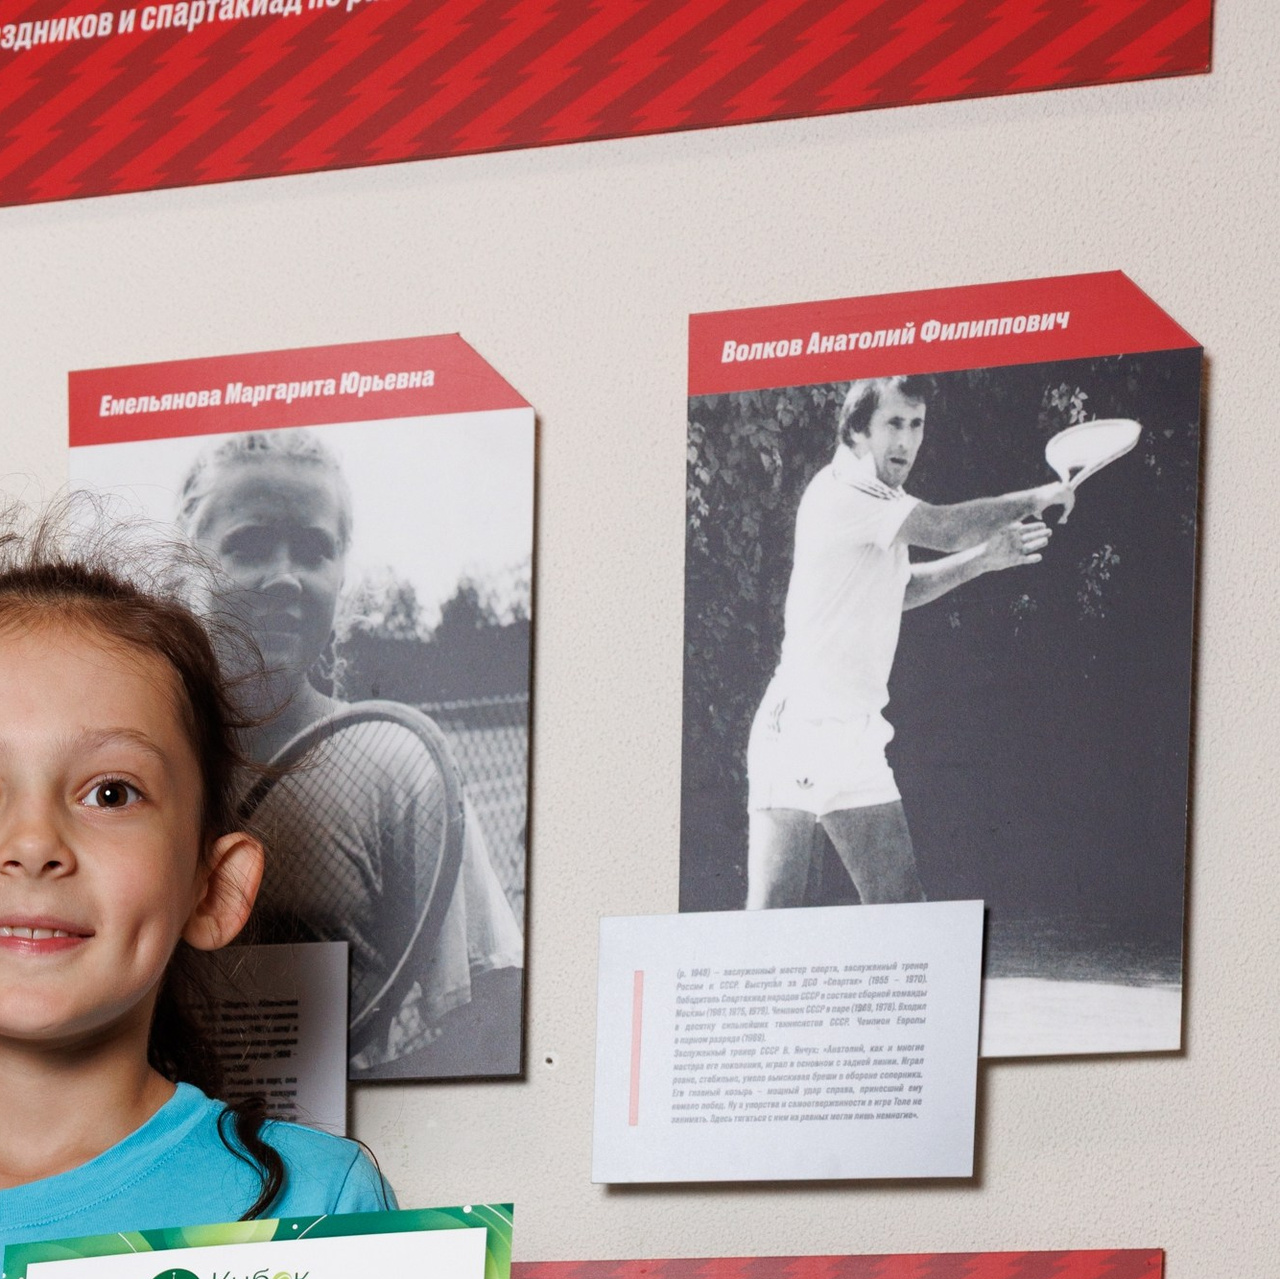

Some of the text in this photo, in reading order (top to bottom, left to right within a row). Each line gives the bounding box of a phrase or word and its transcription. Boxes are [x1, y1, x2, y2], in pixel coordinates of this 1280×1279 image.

[117, 9, 137, 34] и
[721, 312, 1070, 363] Волков Анатолий Филиппович
[99, 369, 435, 417] Емельянова Маргарита Юрьевна
